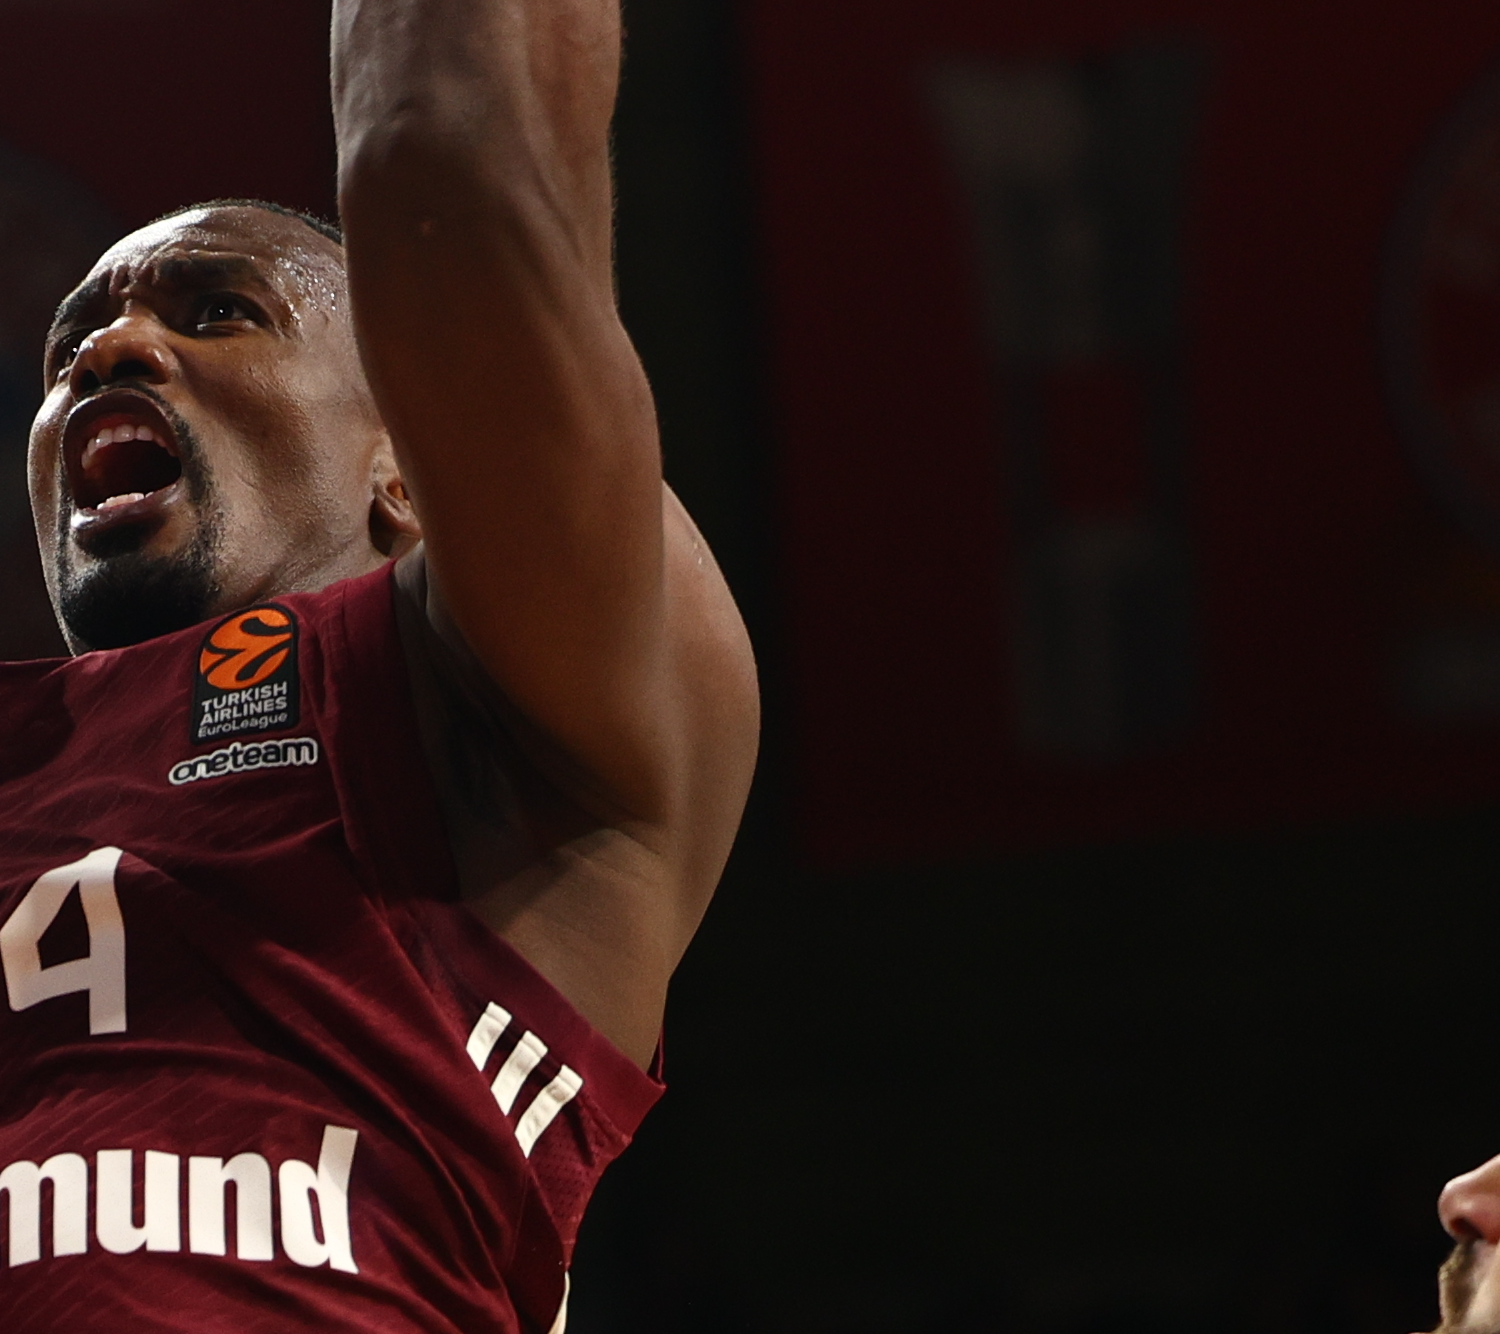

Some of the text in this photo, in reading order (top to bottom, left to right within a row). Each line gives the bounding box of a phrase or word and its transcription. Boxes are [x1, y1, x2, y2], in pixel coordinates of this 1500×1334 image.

[199, 697, 288, 727] AIRLINES
[201, 681, 288, 714] TURKISH
[196, 713, 289, 739] EuroLeague
[171, 739, 316, 782] oneteam
